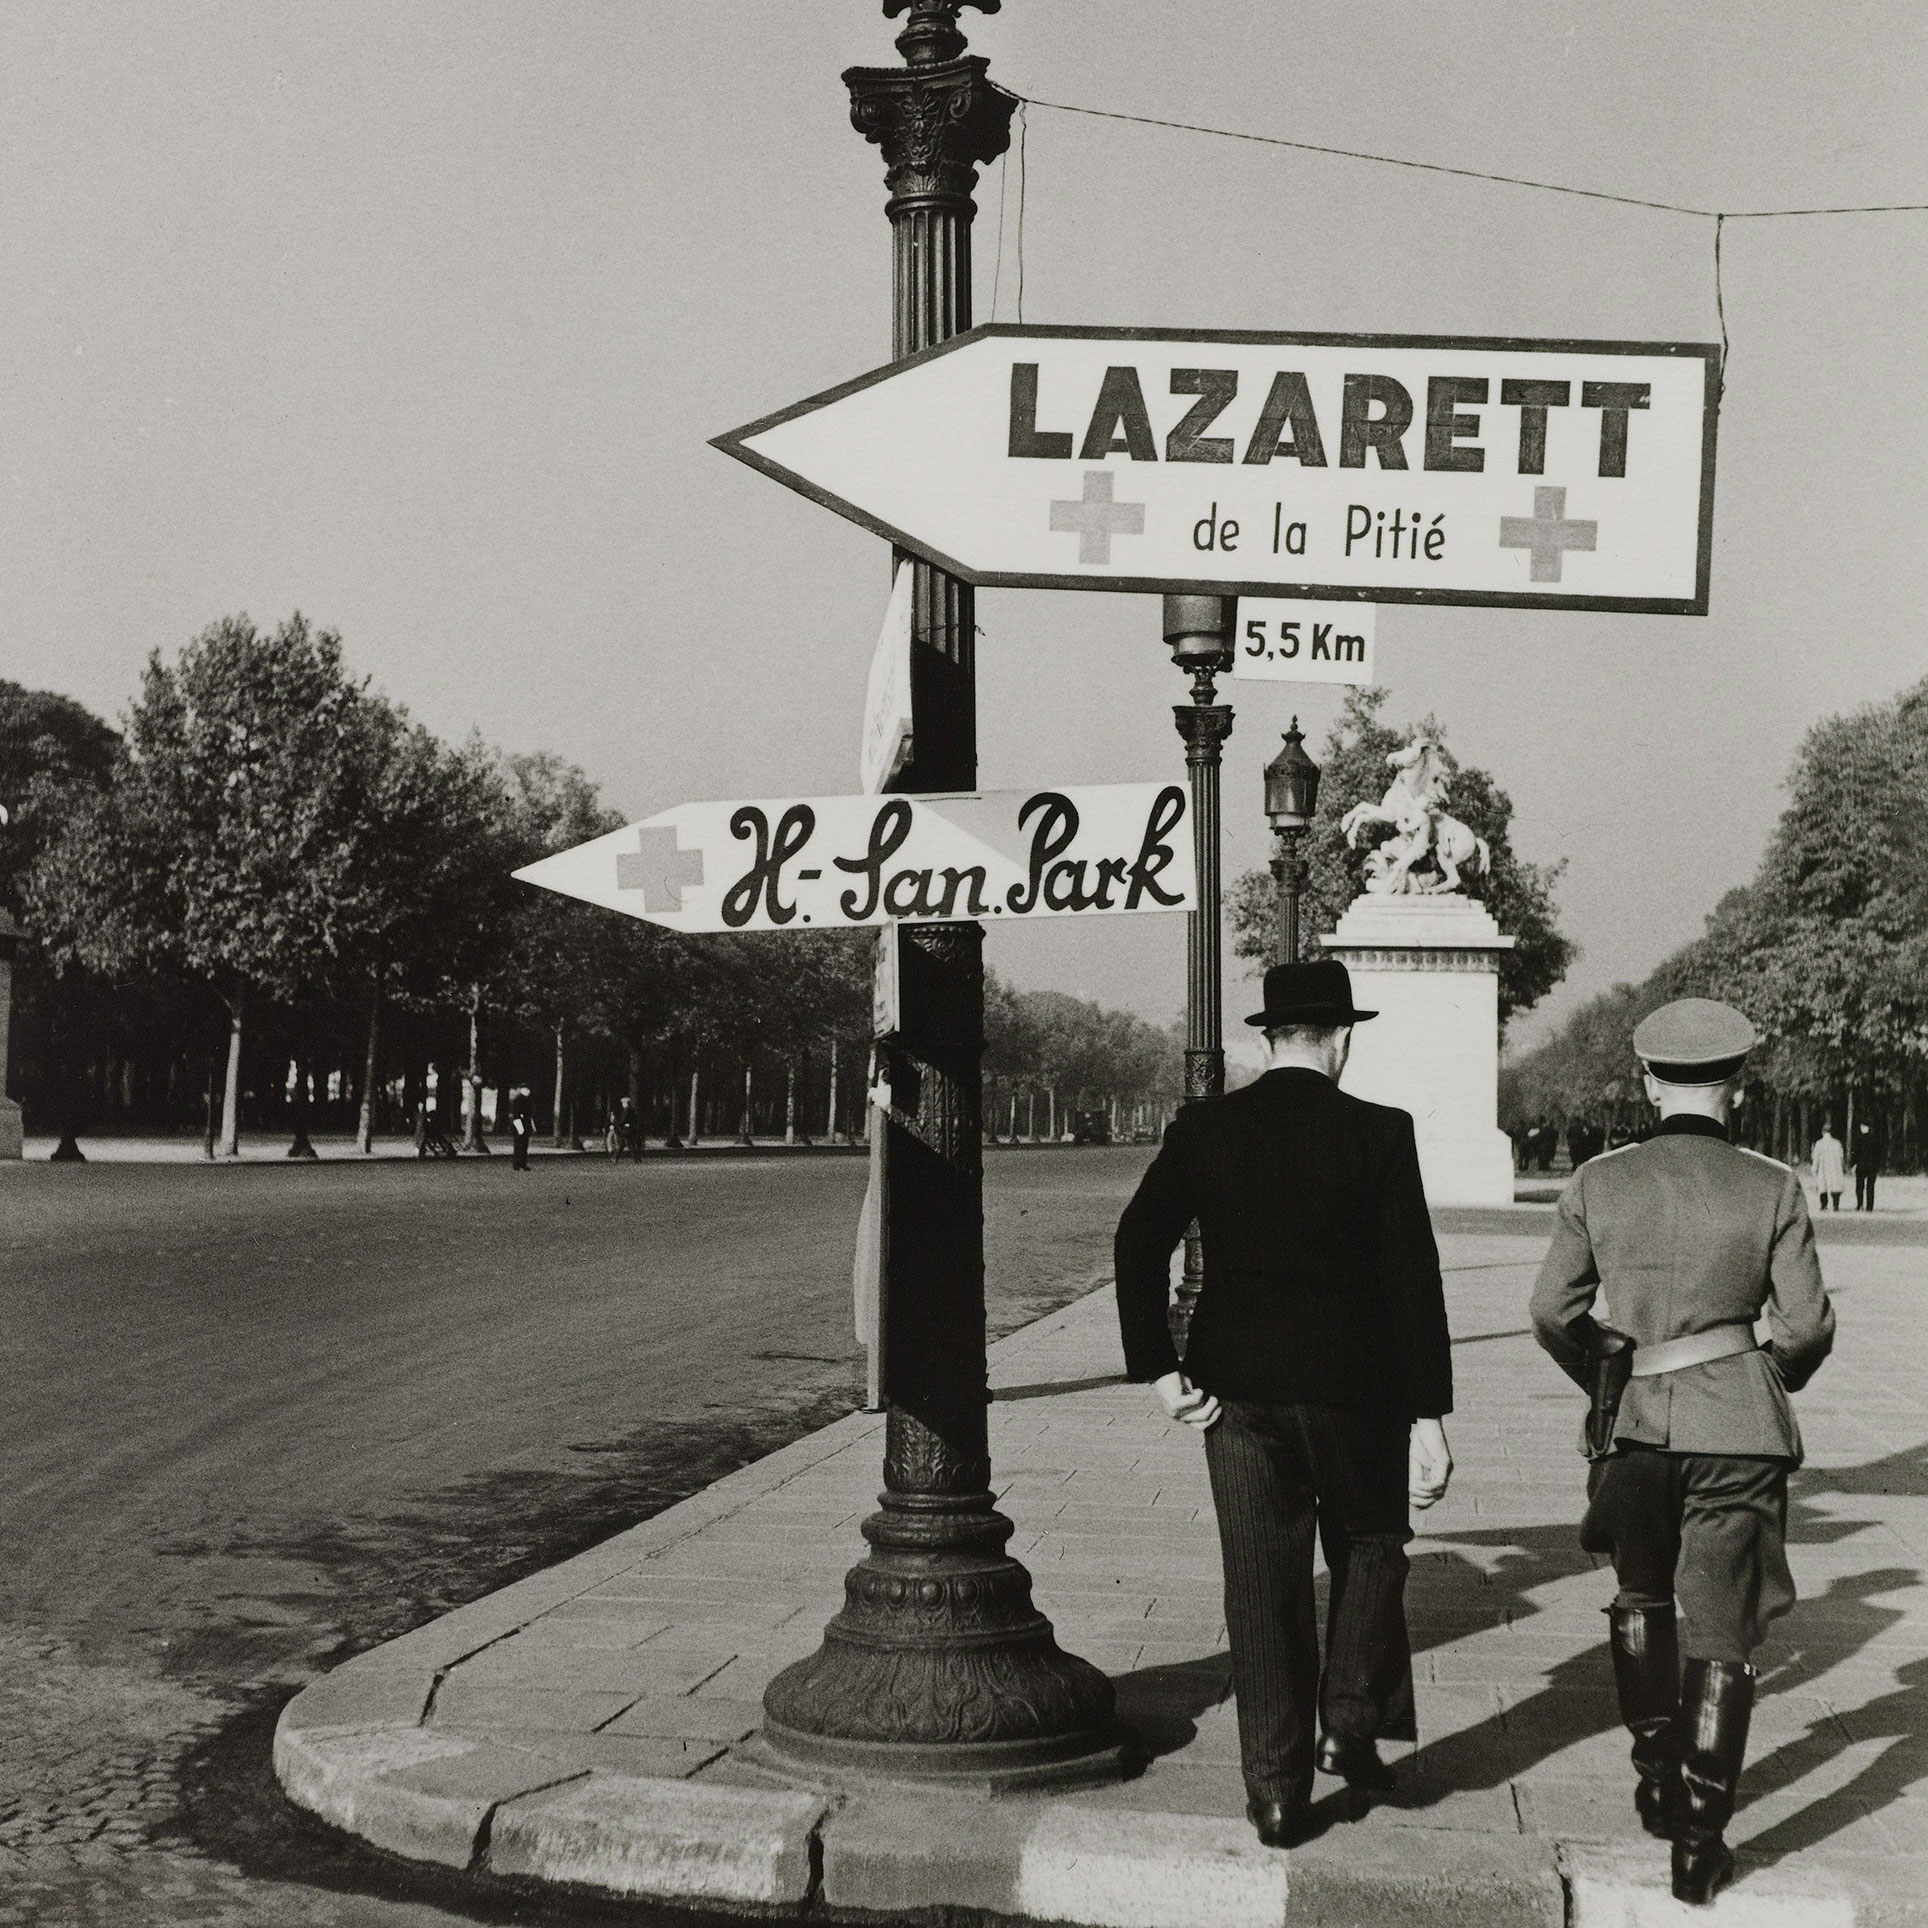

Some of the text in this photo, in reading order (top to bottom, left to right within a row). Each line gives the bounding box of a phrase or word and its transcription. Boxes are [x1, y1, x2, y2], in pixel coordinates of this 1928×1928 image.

[1007, 362, 1651, 479] LAZARETT
[1193, 501, 1446, 561] de la Pitié
[1245, 620, 1365, 662] 5,5 Km
